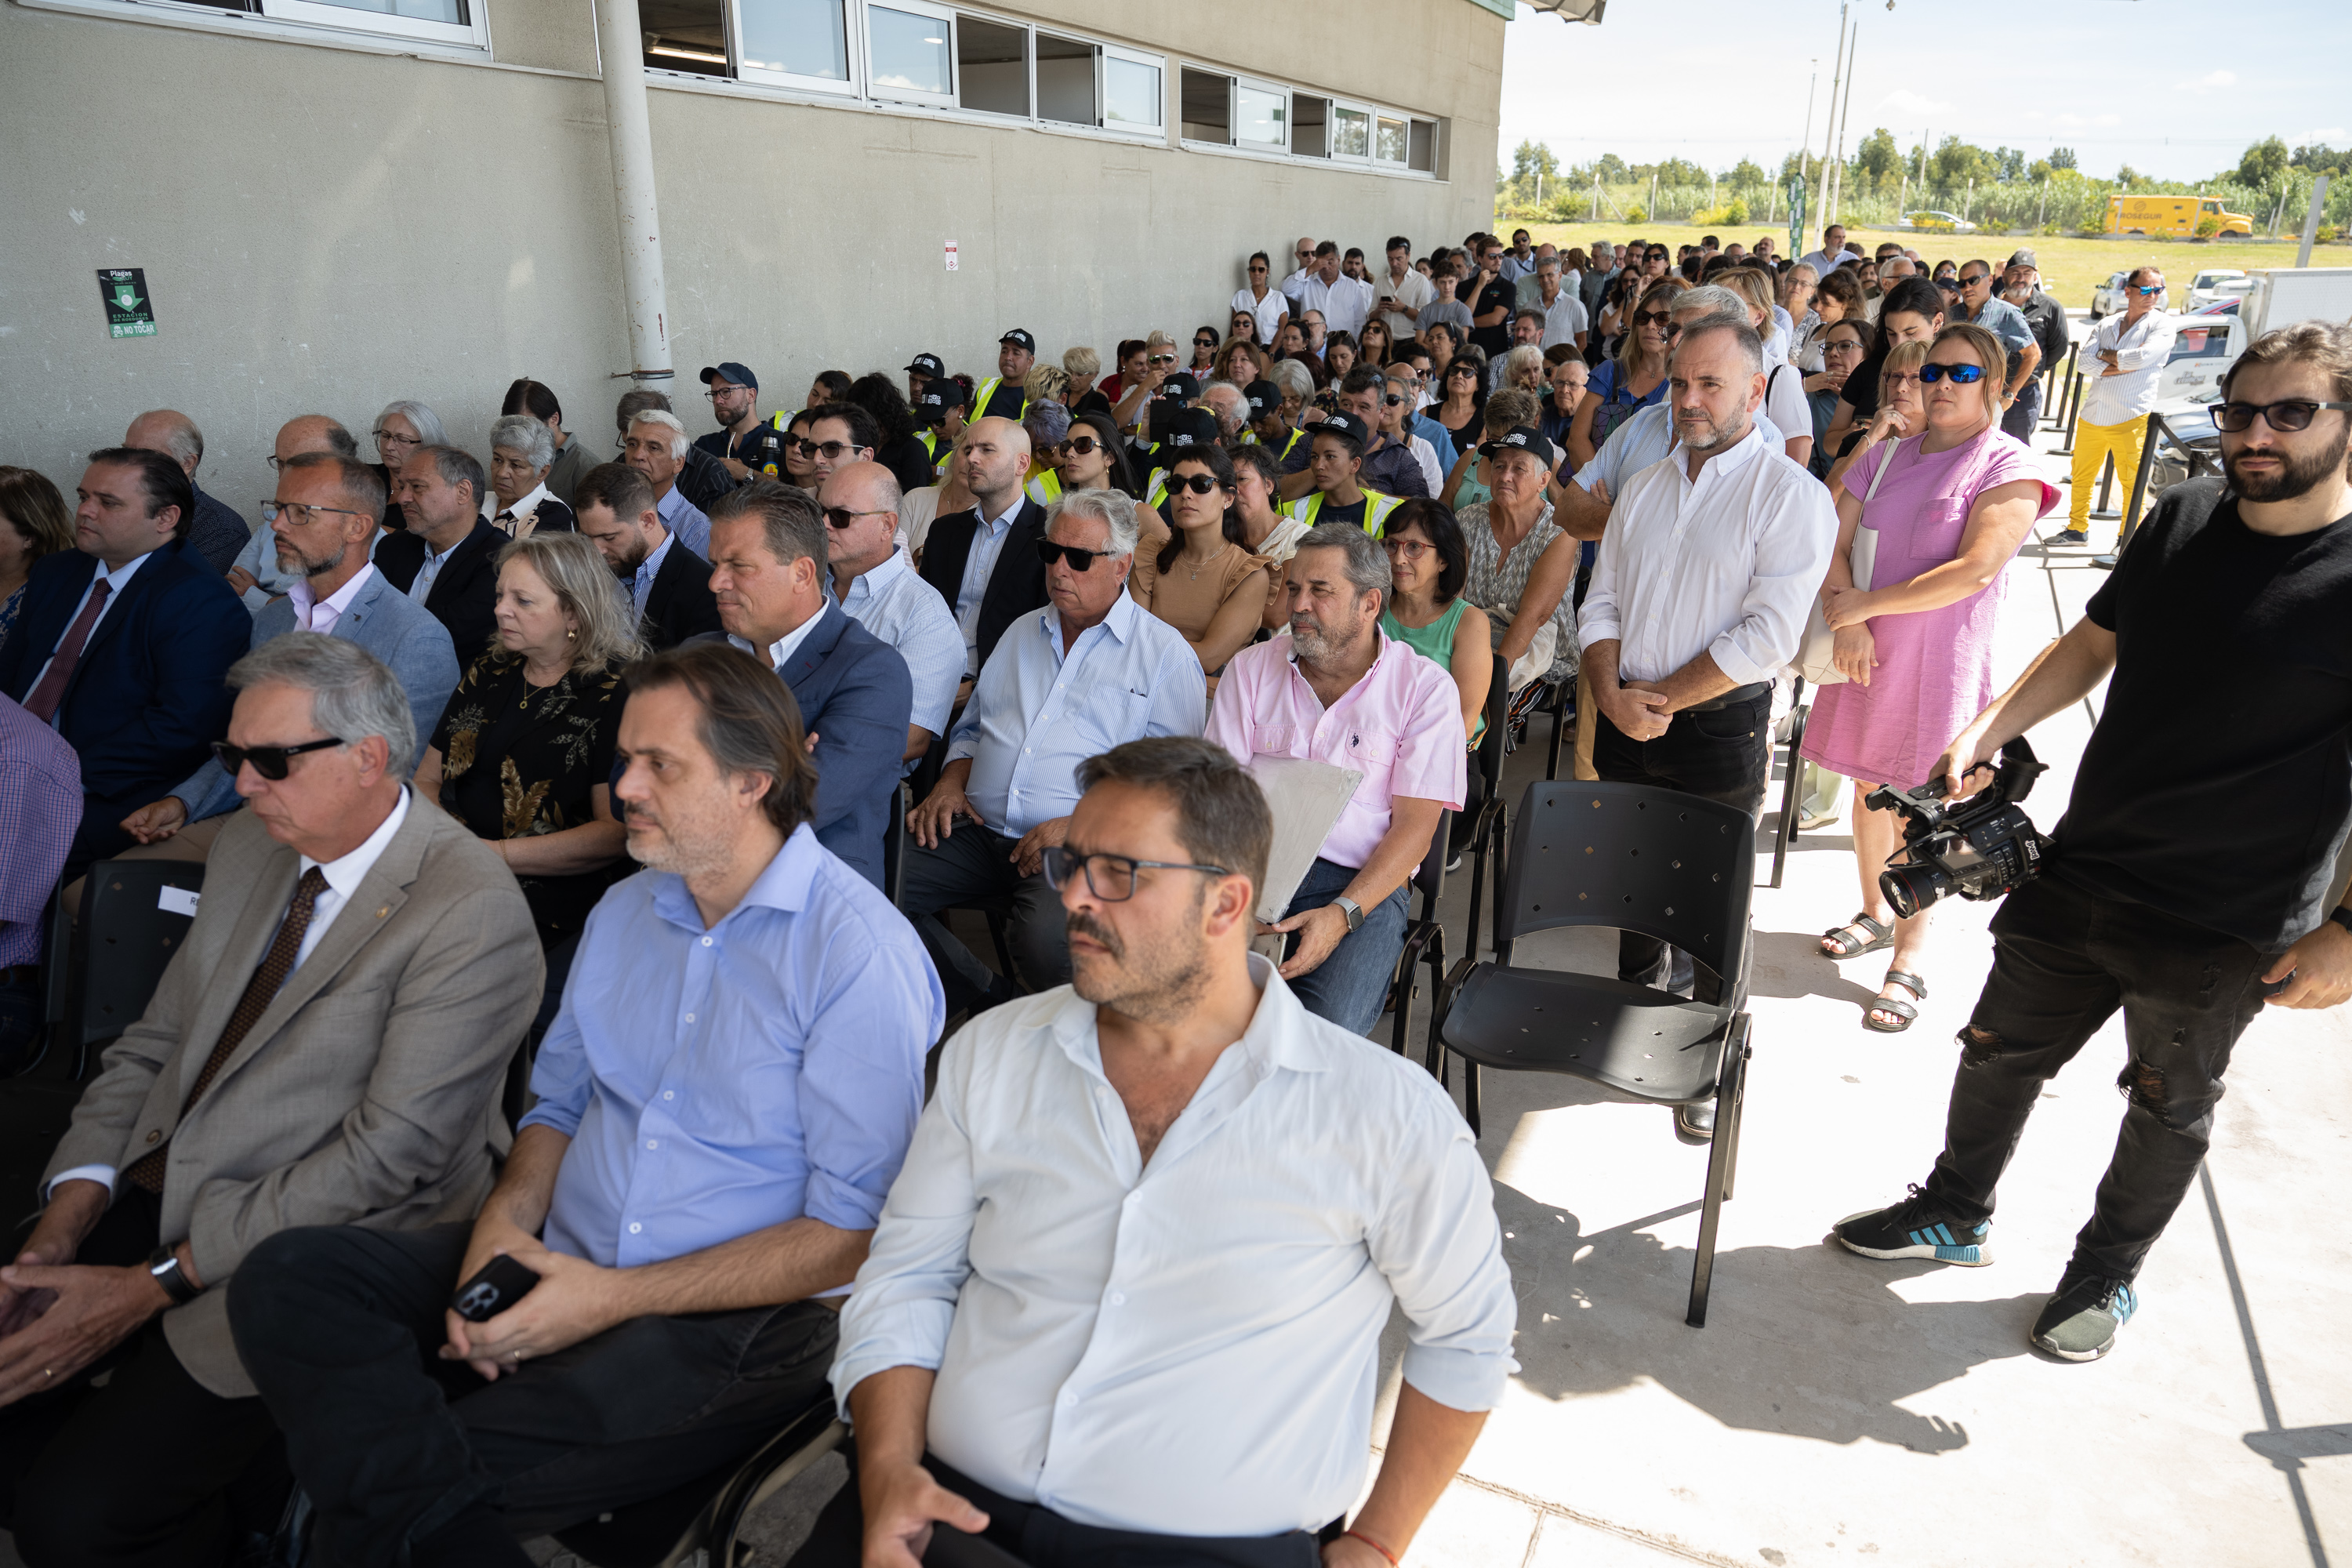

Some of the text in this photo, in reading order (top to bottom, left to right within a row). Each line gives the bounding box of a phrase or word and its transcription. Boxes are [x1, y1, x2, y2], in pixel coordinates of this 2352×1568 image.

[110, 270, 132, 278] Plagas
[123, 324, 155, 335] NO TOCAR
